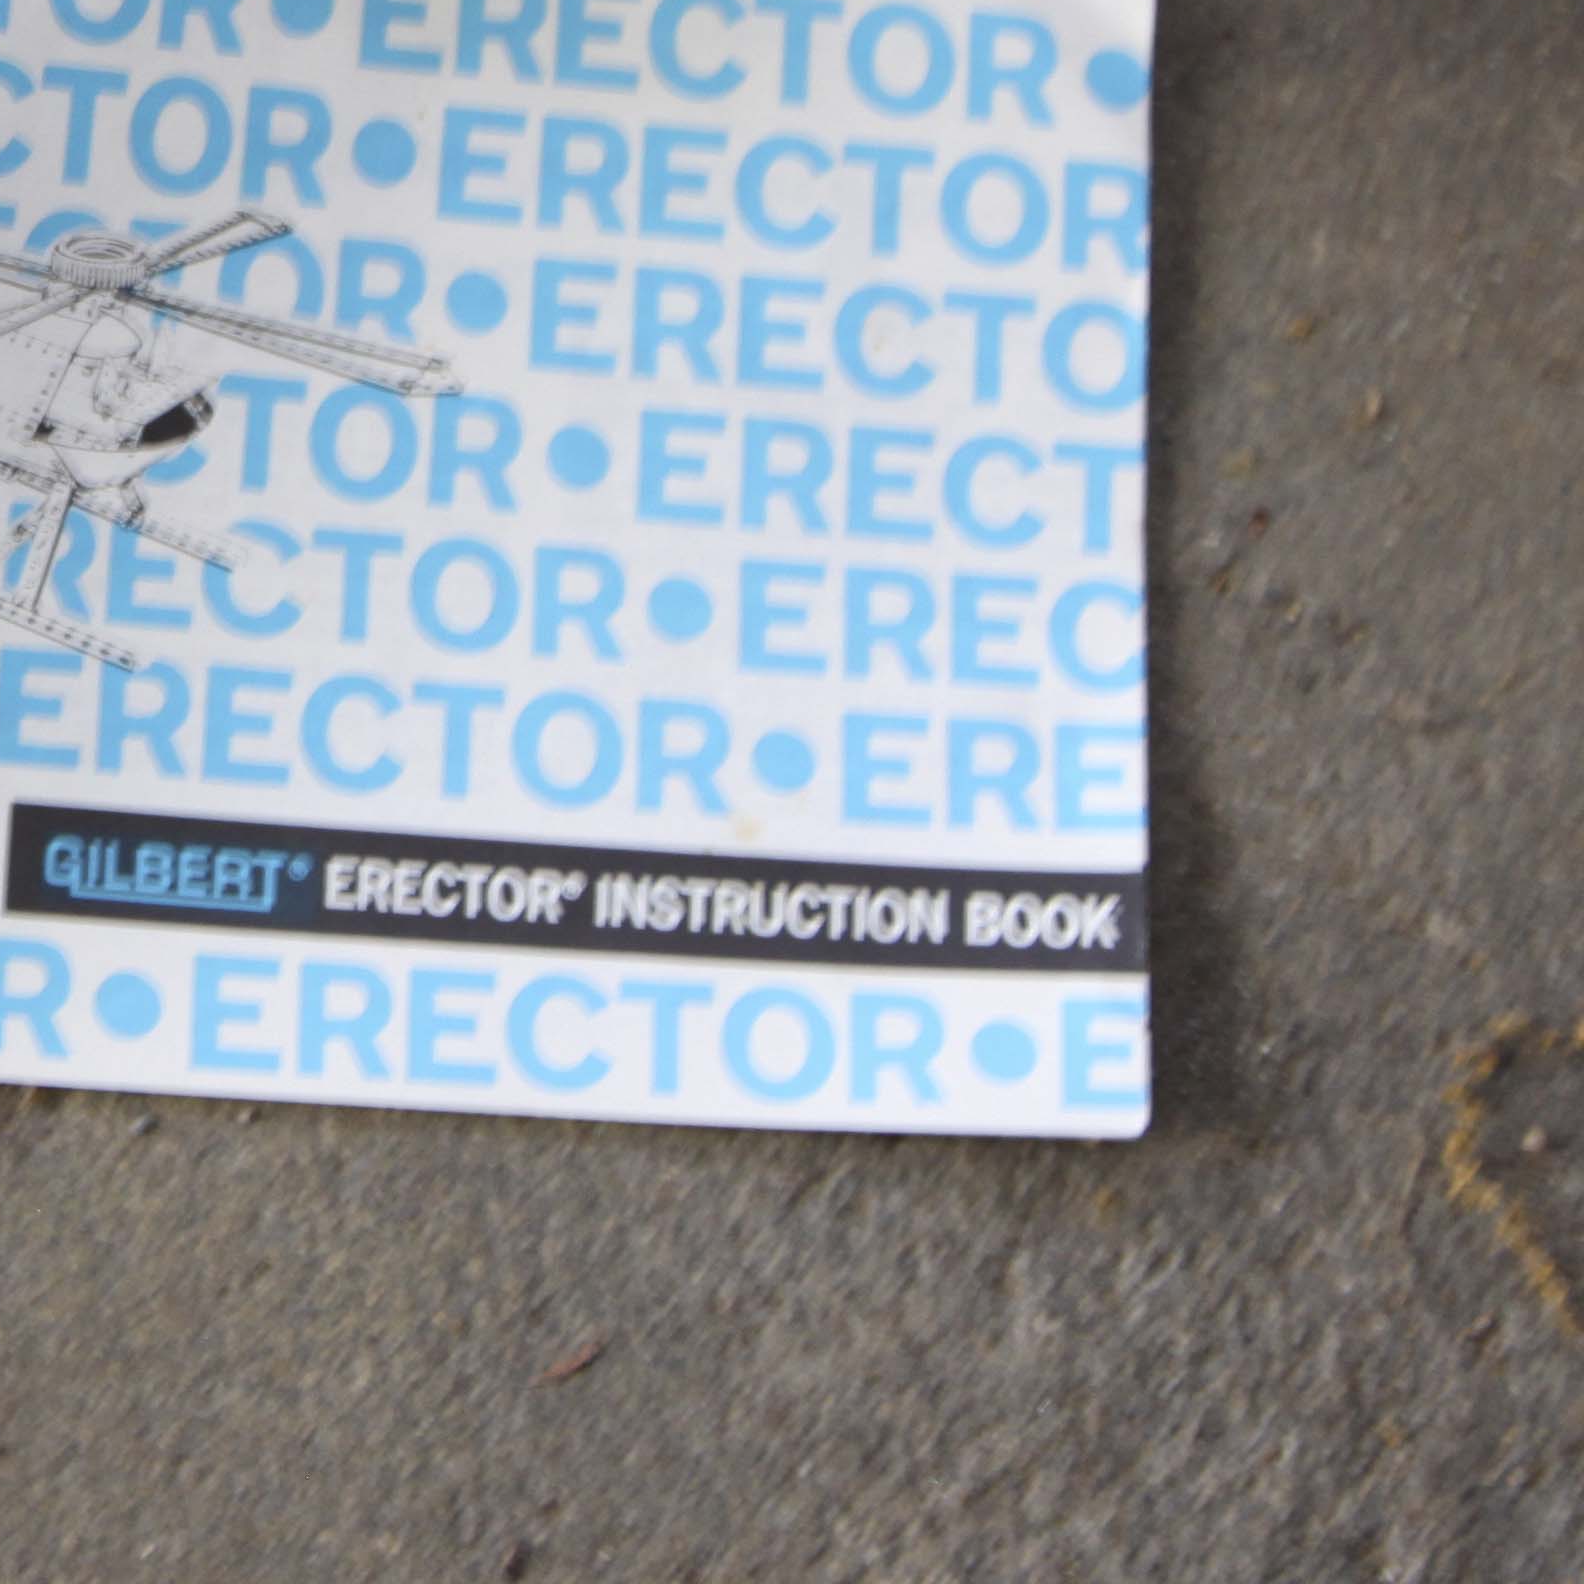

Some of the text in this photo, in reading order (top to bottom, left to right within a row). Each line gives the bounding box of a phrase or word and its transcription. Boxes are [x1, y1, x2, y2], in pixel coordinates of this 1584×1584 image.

[437, 106, 1150, 275] ERECTOR
[526, 257, 1150, 414] ERECTO
[634, 407, 1147, 555] ERECT
[736, 557, 1148, 695] EREC
[839, 709, 1150, 834] ERE
[592, 869, 951, 947] INSTRUCTION
[961, 889, 1124, 952] BOOK
[189, 952, 947, 1105] ERECTOR
